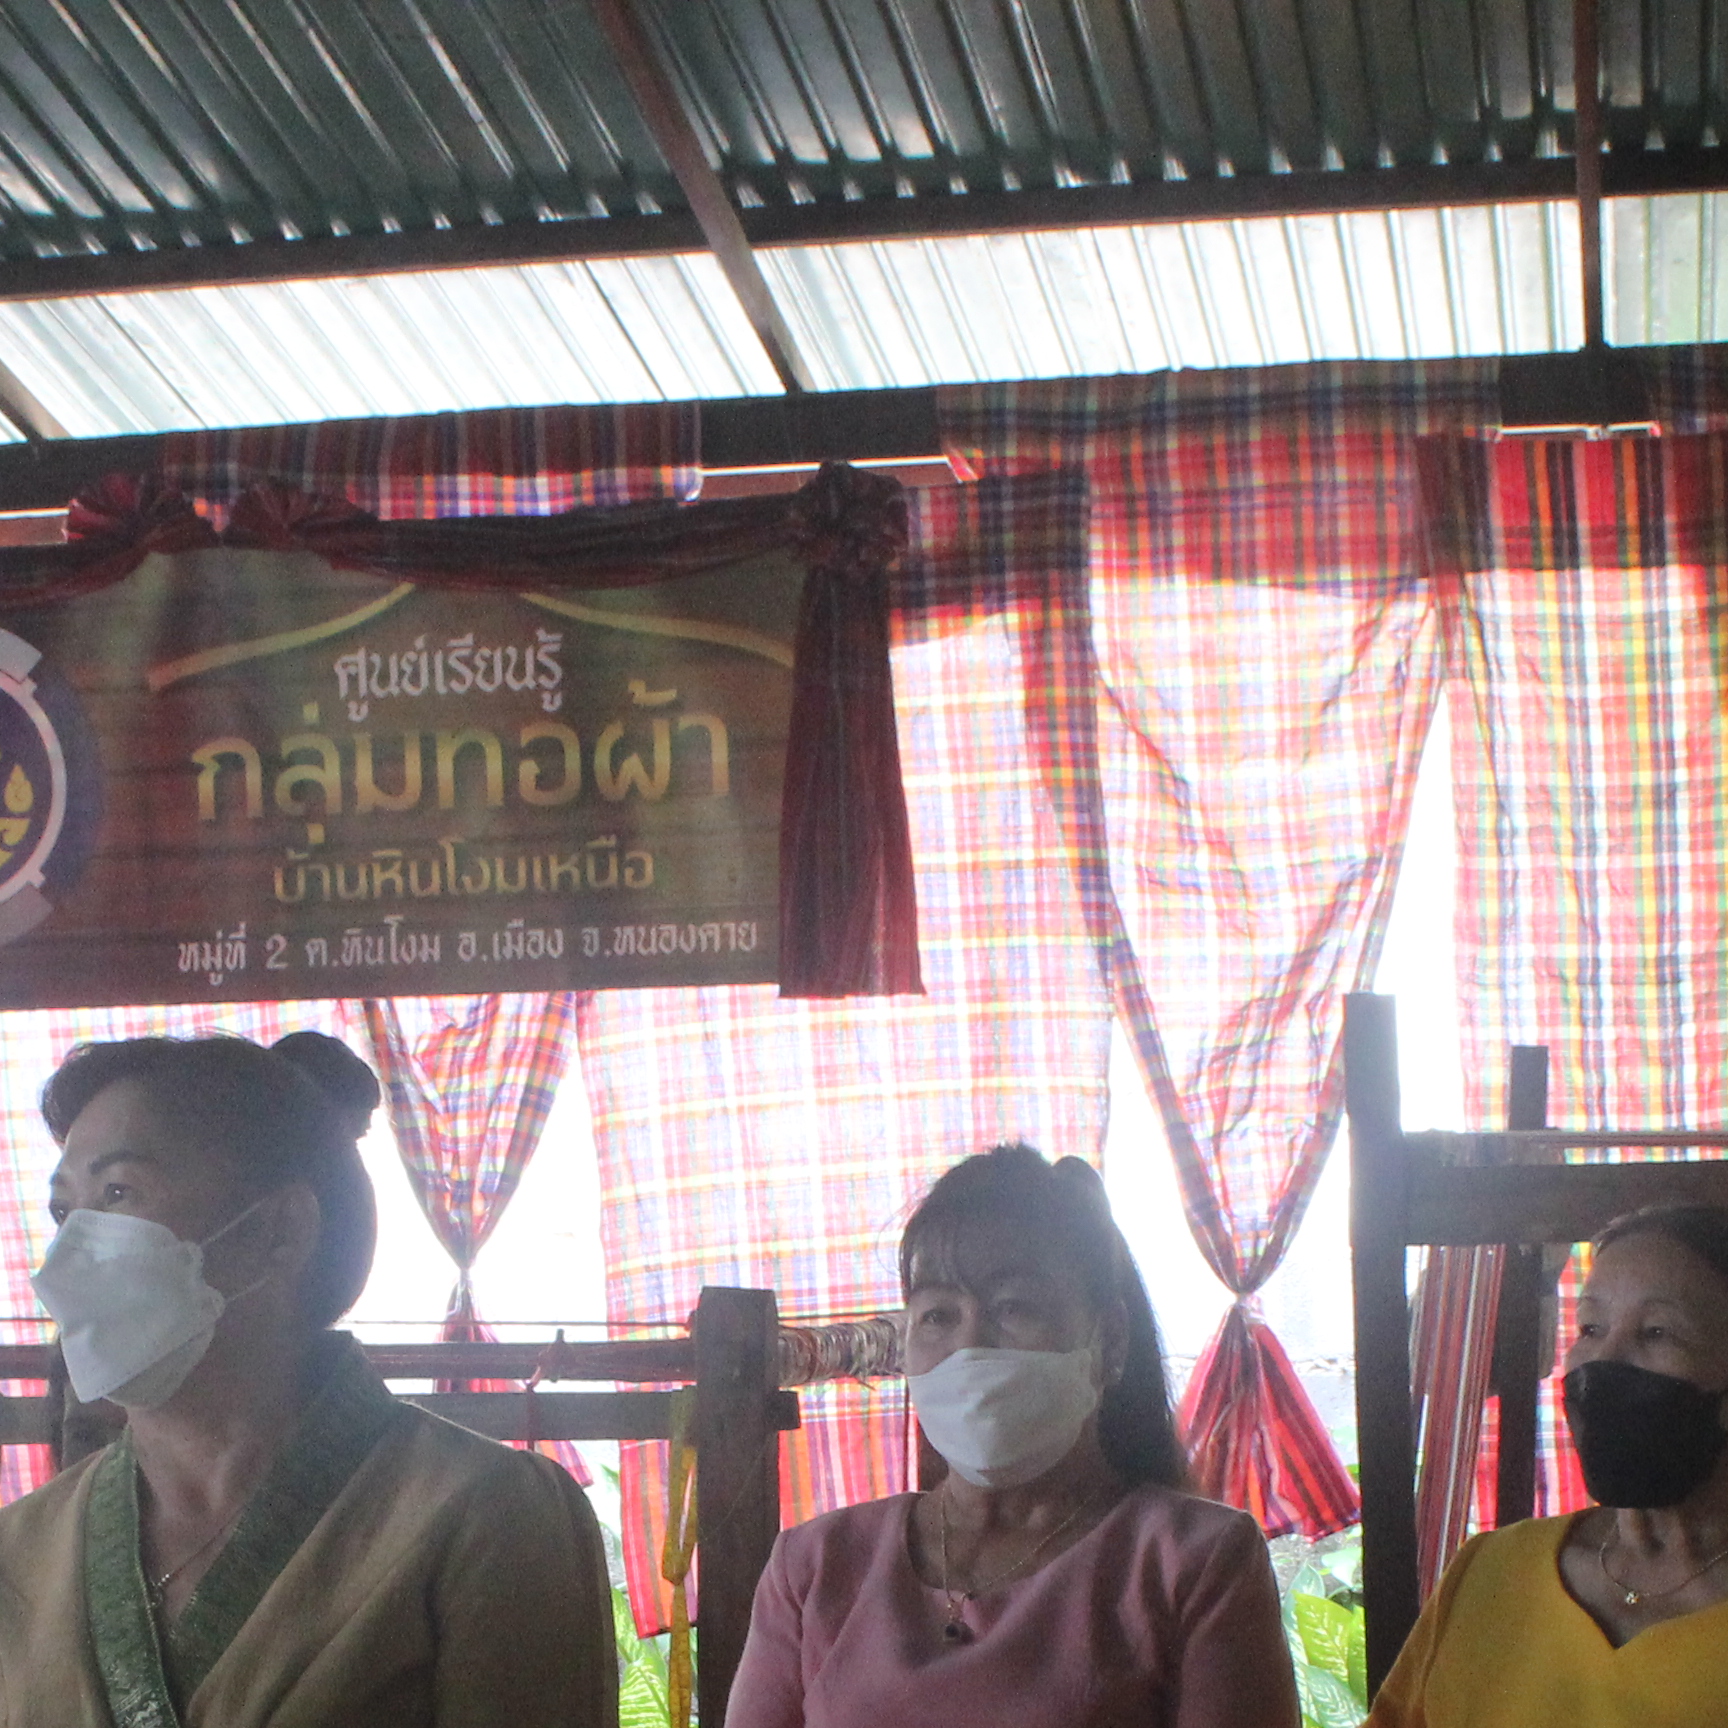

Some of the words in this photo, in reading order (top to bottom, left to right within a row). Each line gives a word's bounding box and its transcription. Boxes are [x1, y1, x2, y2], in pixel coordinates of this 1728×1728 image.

[333, 626, 565, 722] ศูนย์เรียนรู้
[191, 678, 731, 845] กลุ่มทอผ้า
[273, 833, 654, 904] บ้านหินโงมเหนือ
[177, 924, 248, 987] หมู่ที่
[265, 934, 289, 971] 2
[305, 915, 442, 969] ต.หินโงม
[458, 920, 565, 964] อ.เมือง
[582, 919, 759, 960] จ.หนองคาย
